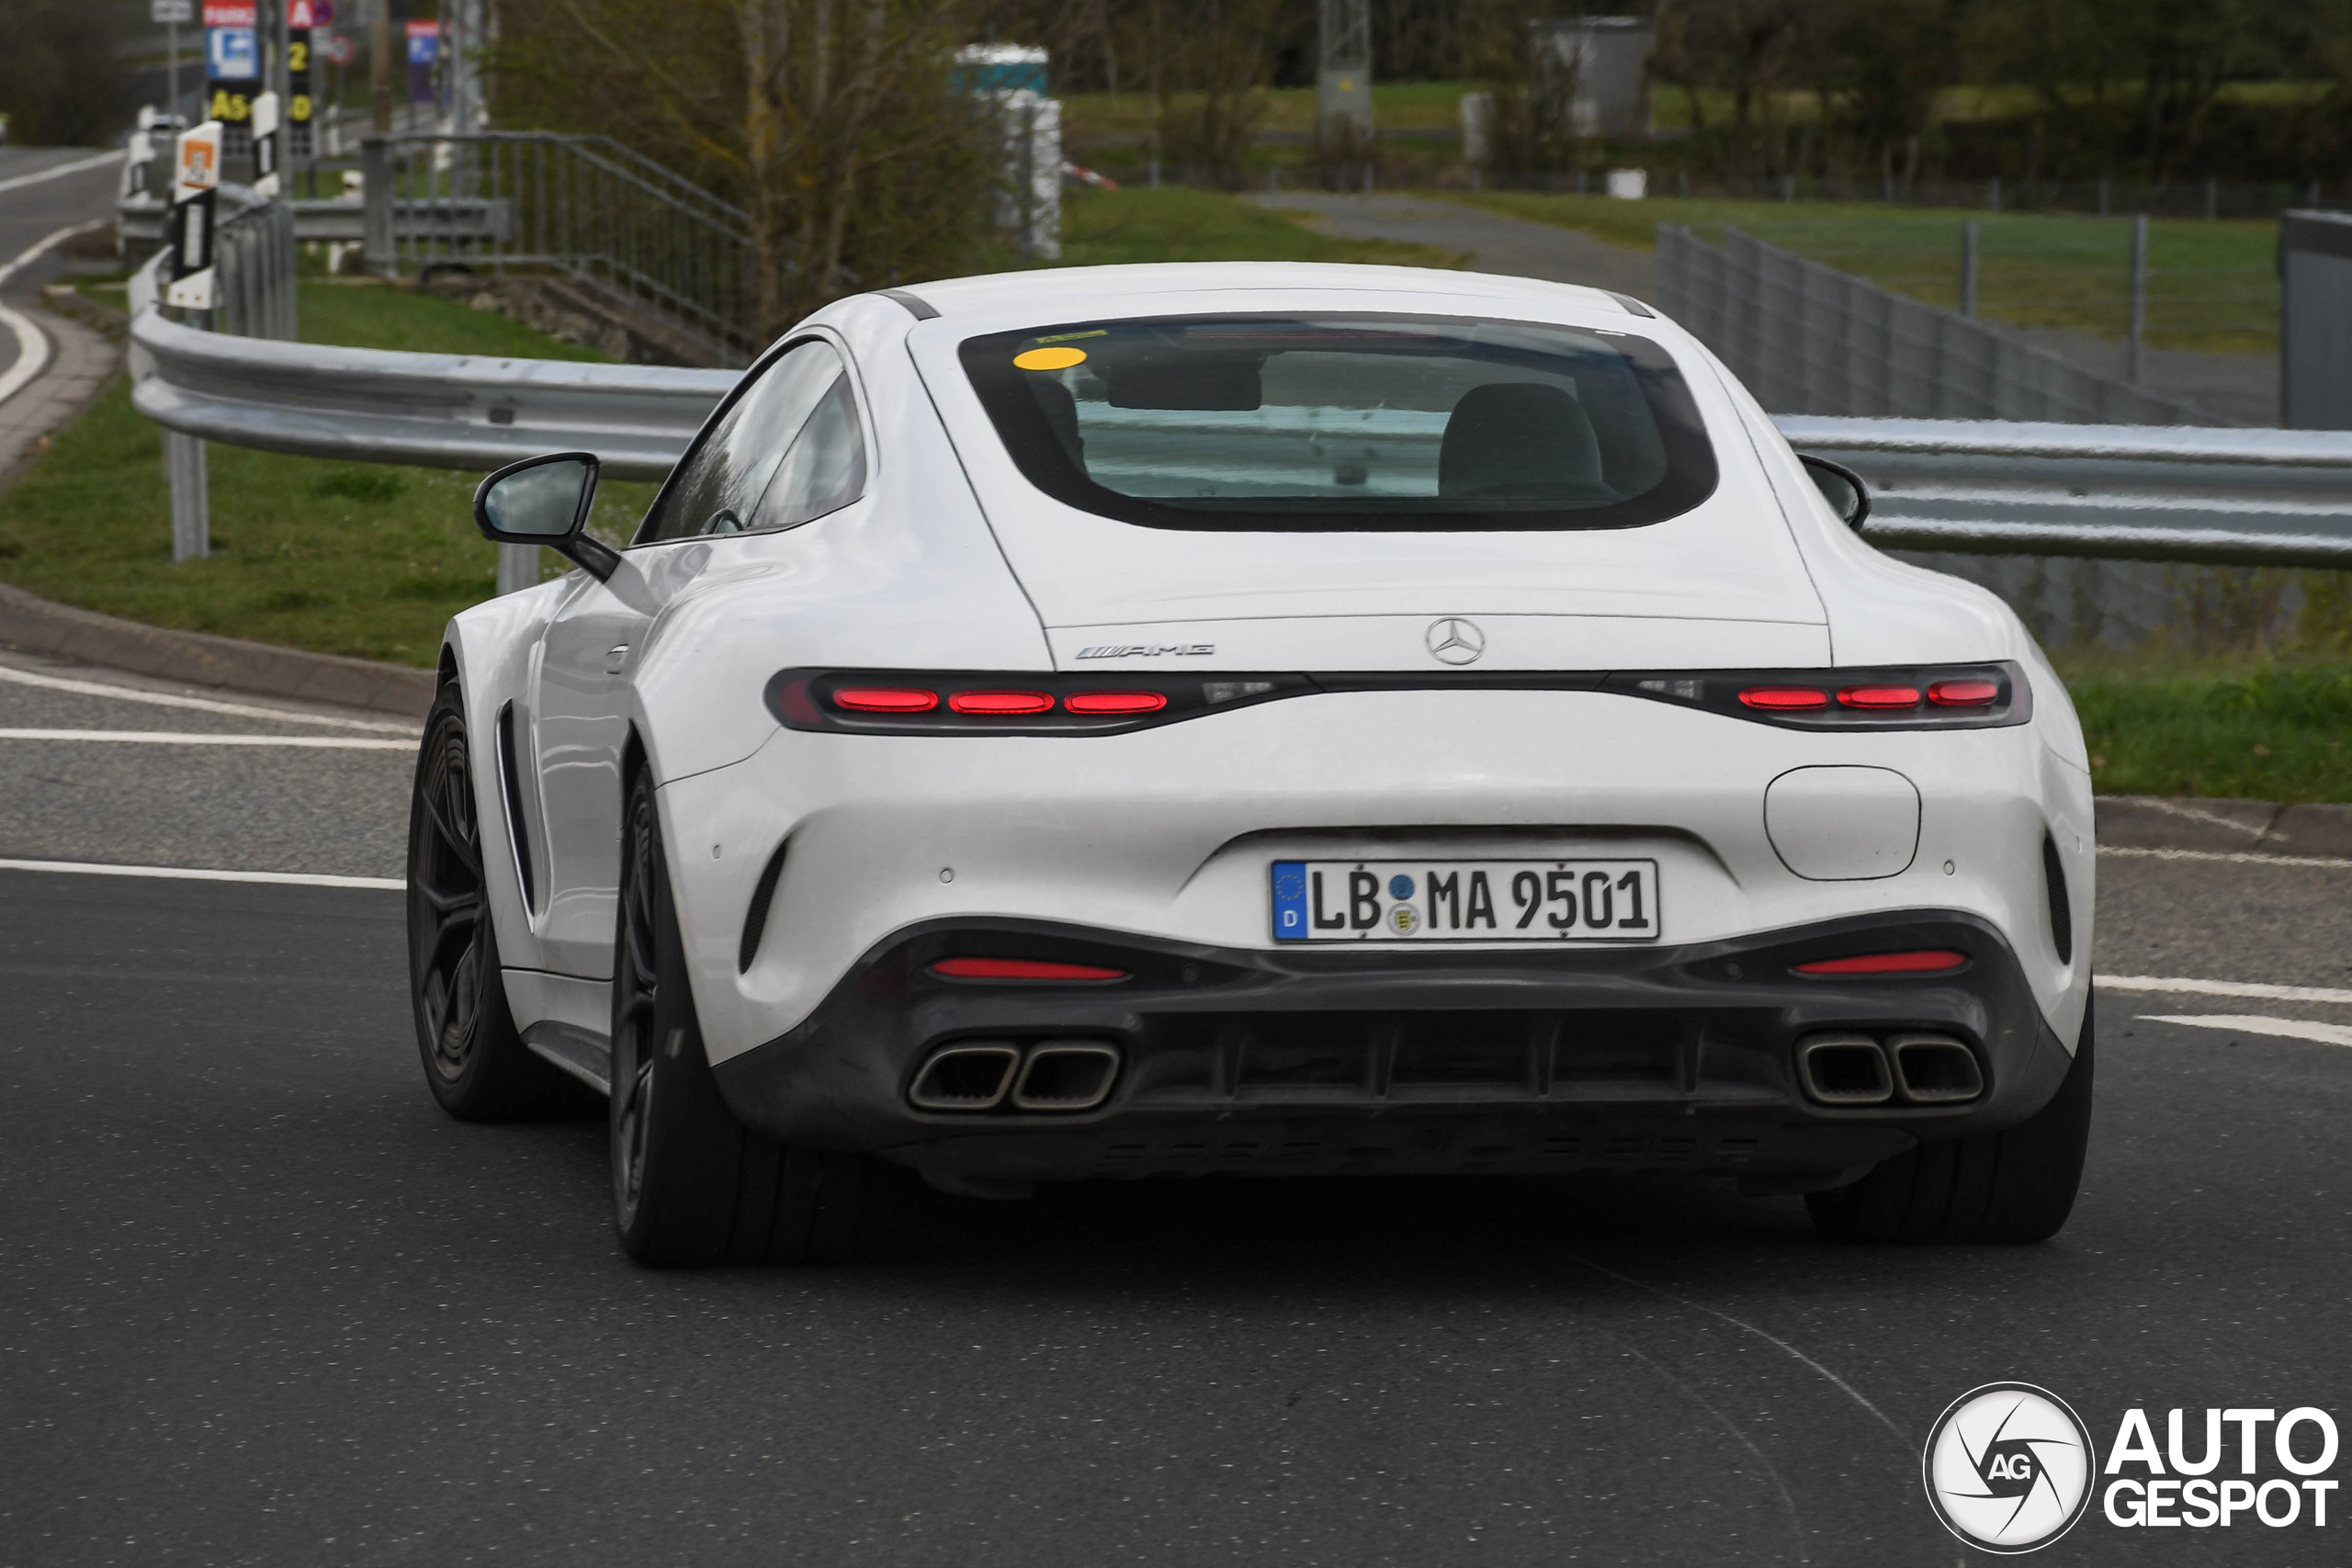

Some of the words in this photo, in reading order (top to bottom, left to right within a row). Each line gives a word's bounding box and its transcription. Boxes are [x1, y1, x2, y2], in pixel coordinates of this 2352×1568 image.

[1112, 644, 1215, 658] AMG
[1312, 871, 1381, 930] LB
[1427, 871, 1498, 930] MA
[1511, 871, 1650, 930] 9501
[1283, 909, 1298, 928] D
